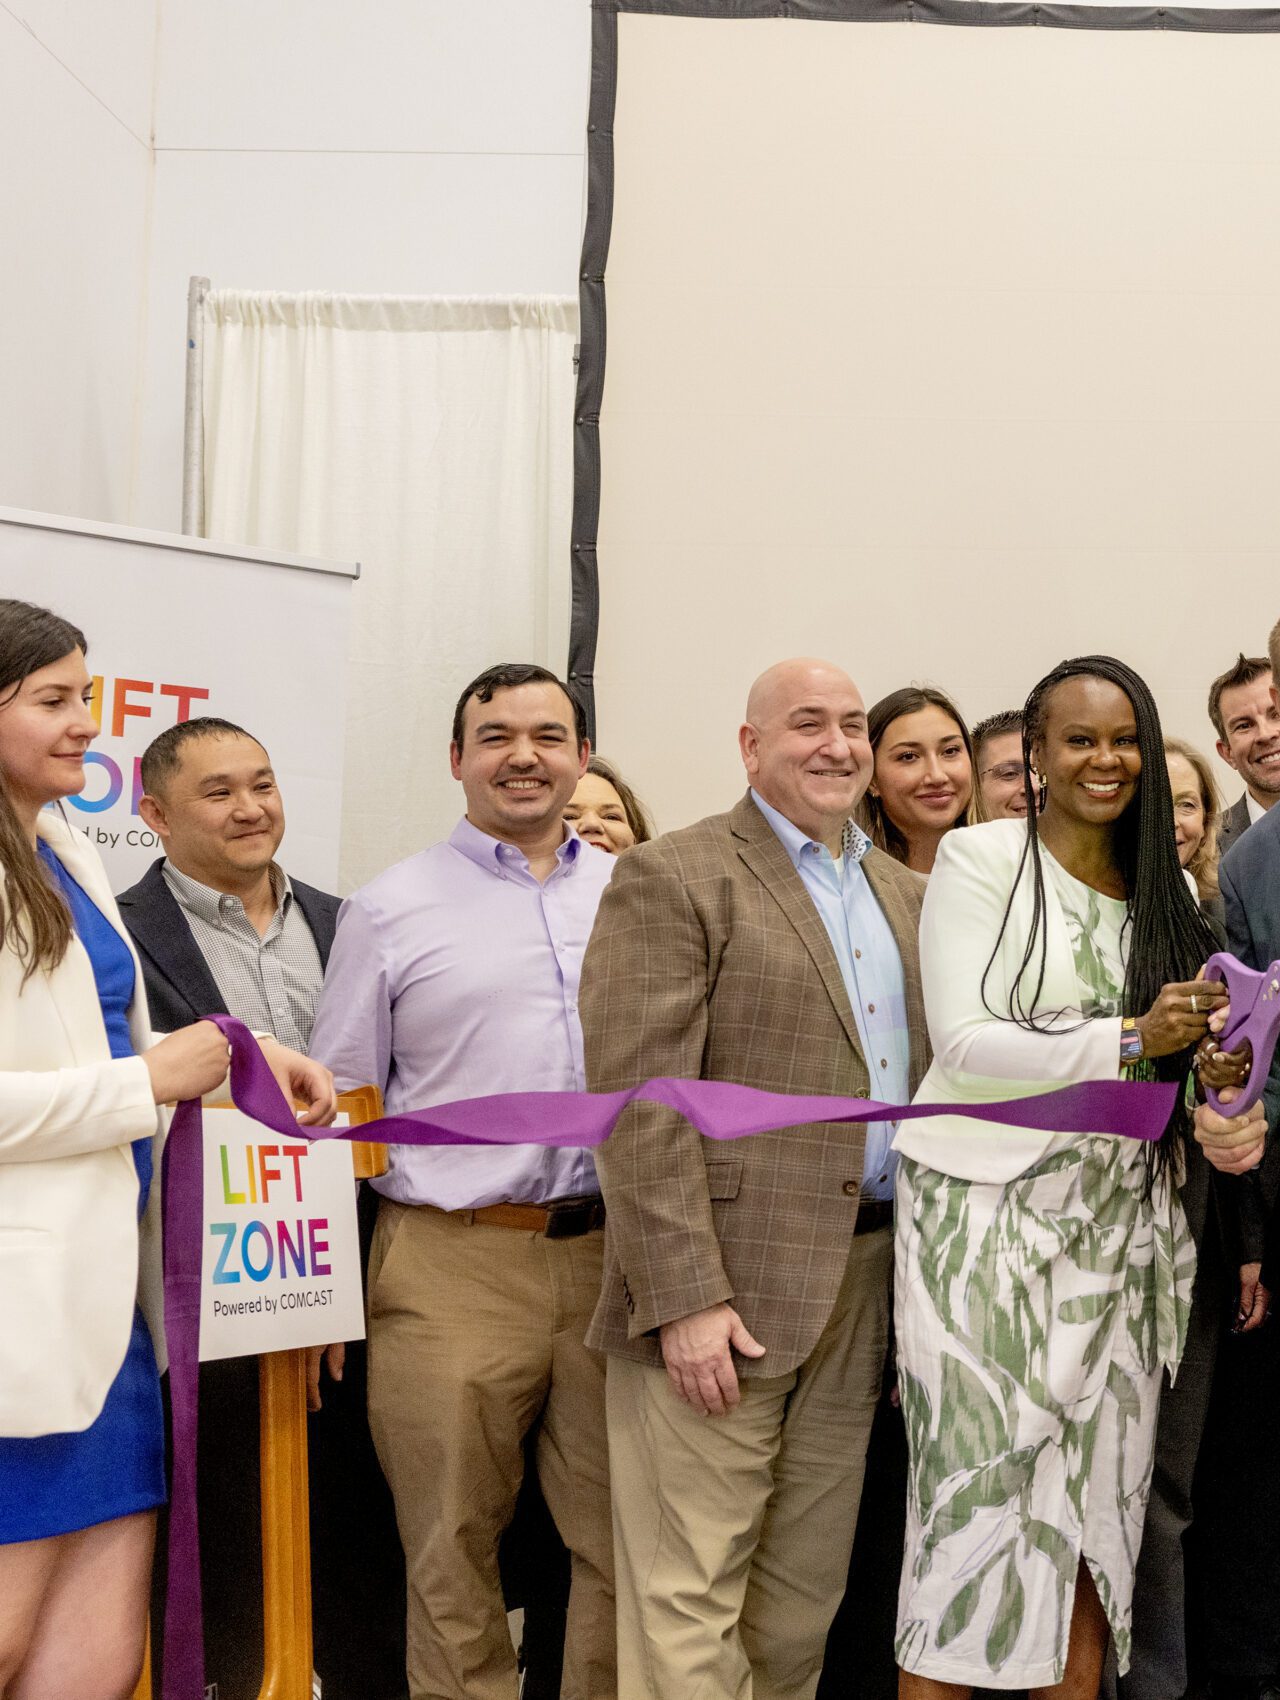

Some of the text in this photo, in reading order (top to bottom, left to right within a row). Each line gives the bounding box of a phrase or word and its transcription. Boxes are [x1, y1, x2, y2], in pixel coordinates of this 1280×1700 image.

[90, 675, 209, 737] IFT
[96, 827, 120, 848] by
[219, 1144, 308, 1205] LIFT
[210, 1218, 332, 1285] ZONE
[213, 1289, 333, 1317] Powered by COMCAST
